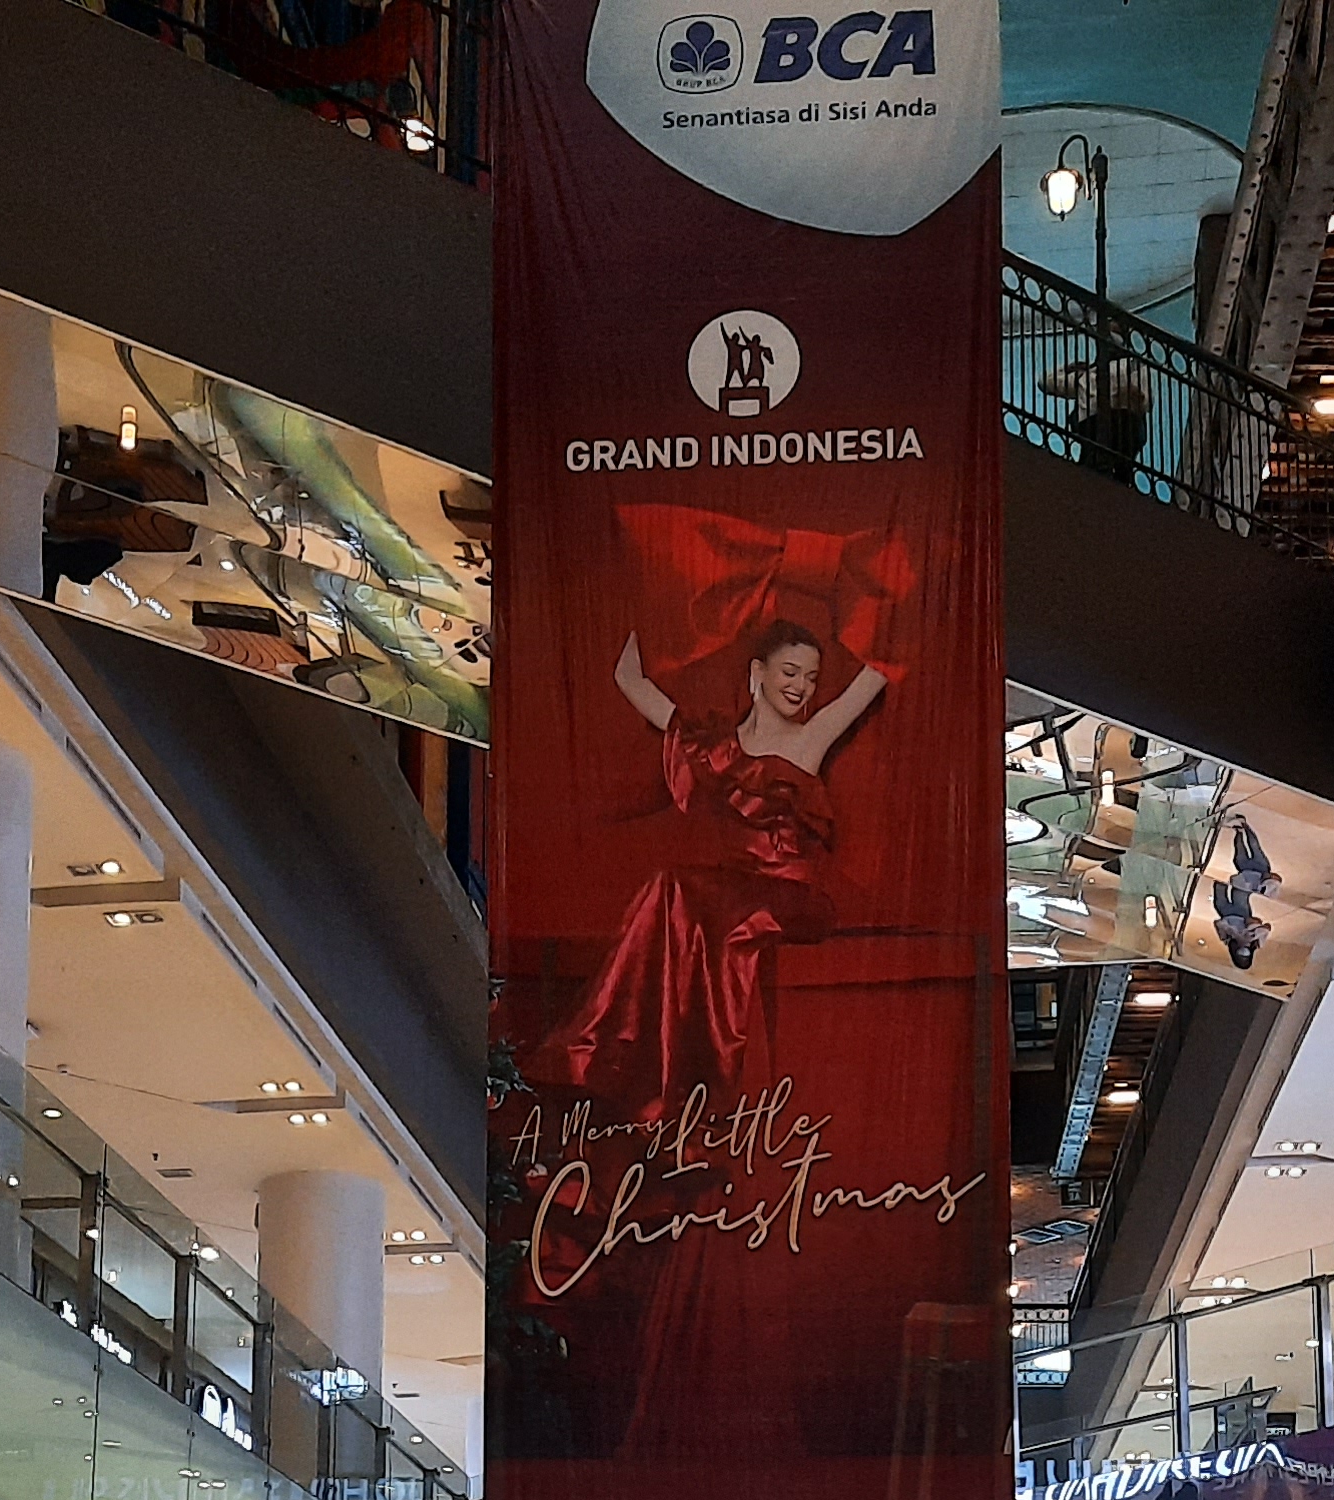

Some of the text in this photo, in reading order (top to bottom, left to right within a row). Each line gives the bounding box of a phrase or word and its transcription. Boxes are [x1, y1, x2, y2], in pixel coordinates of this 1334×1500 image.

[753, 9, 937, 84] BCA
[661, 97, 938, 130] Senantiasa di Sisi Anda
[565, 426, 925, 473] GRAND INDONESIA
[509, 1075, 833, 1181] A Merry Little
[529, 1131, 987, 1298] Christmas
